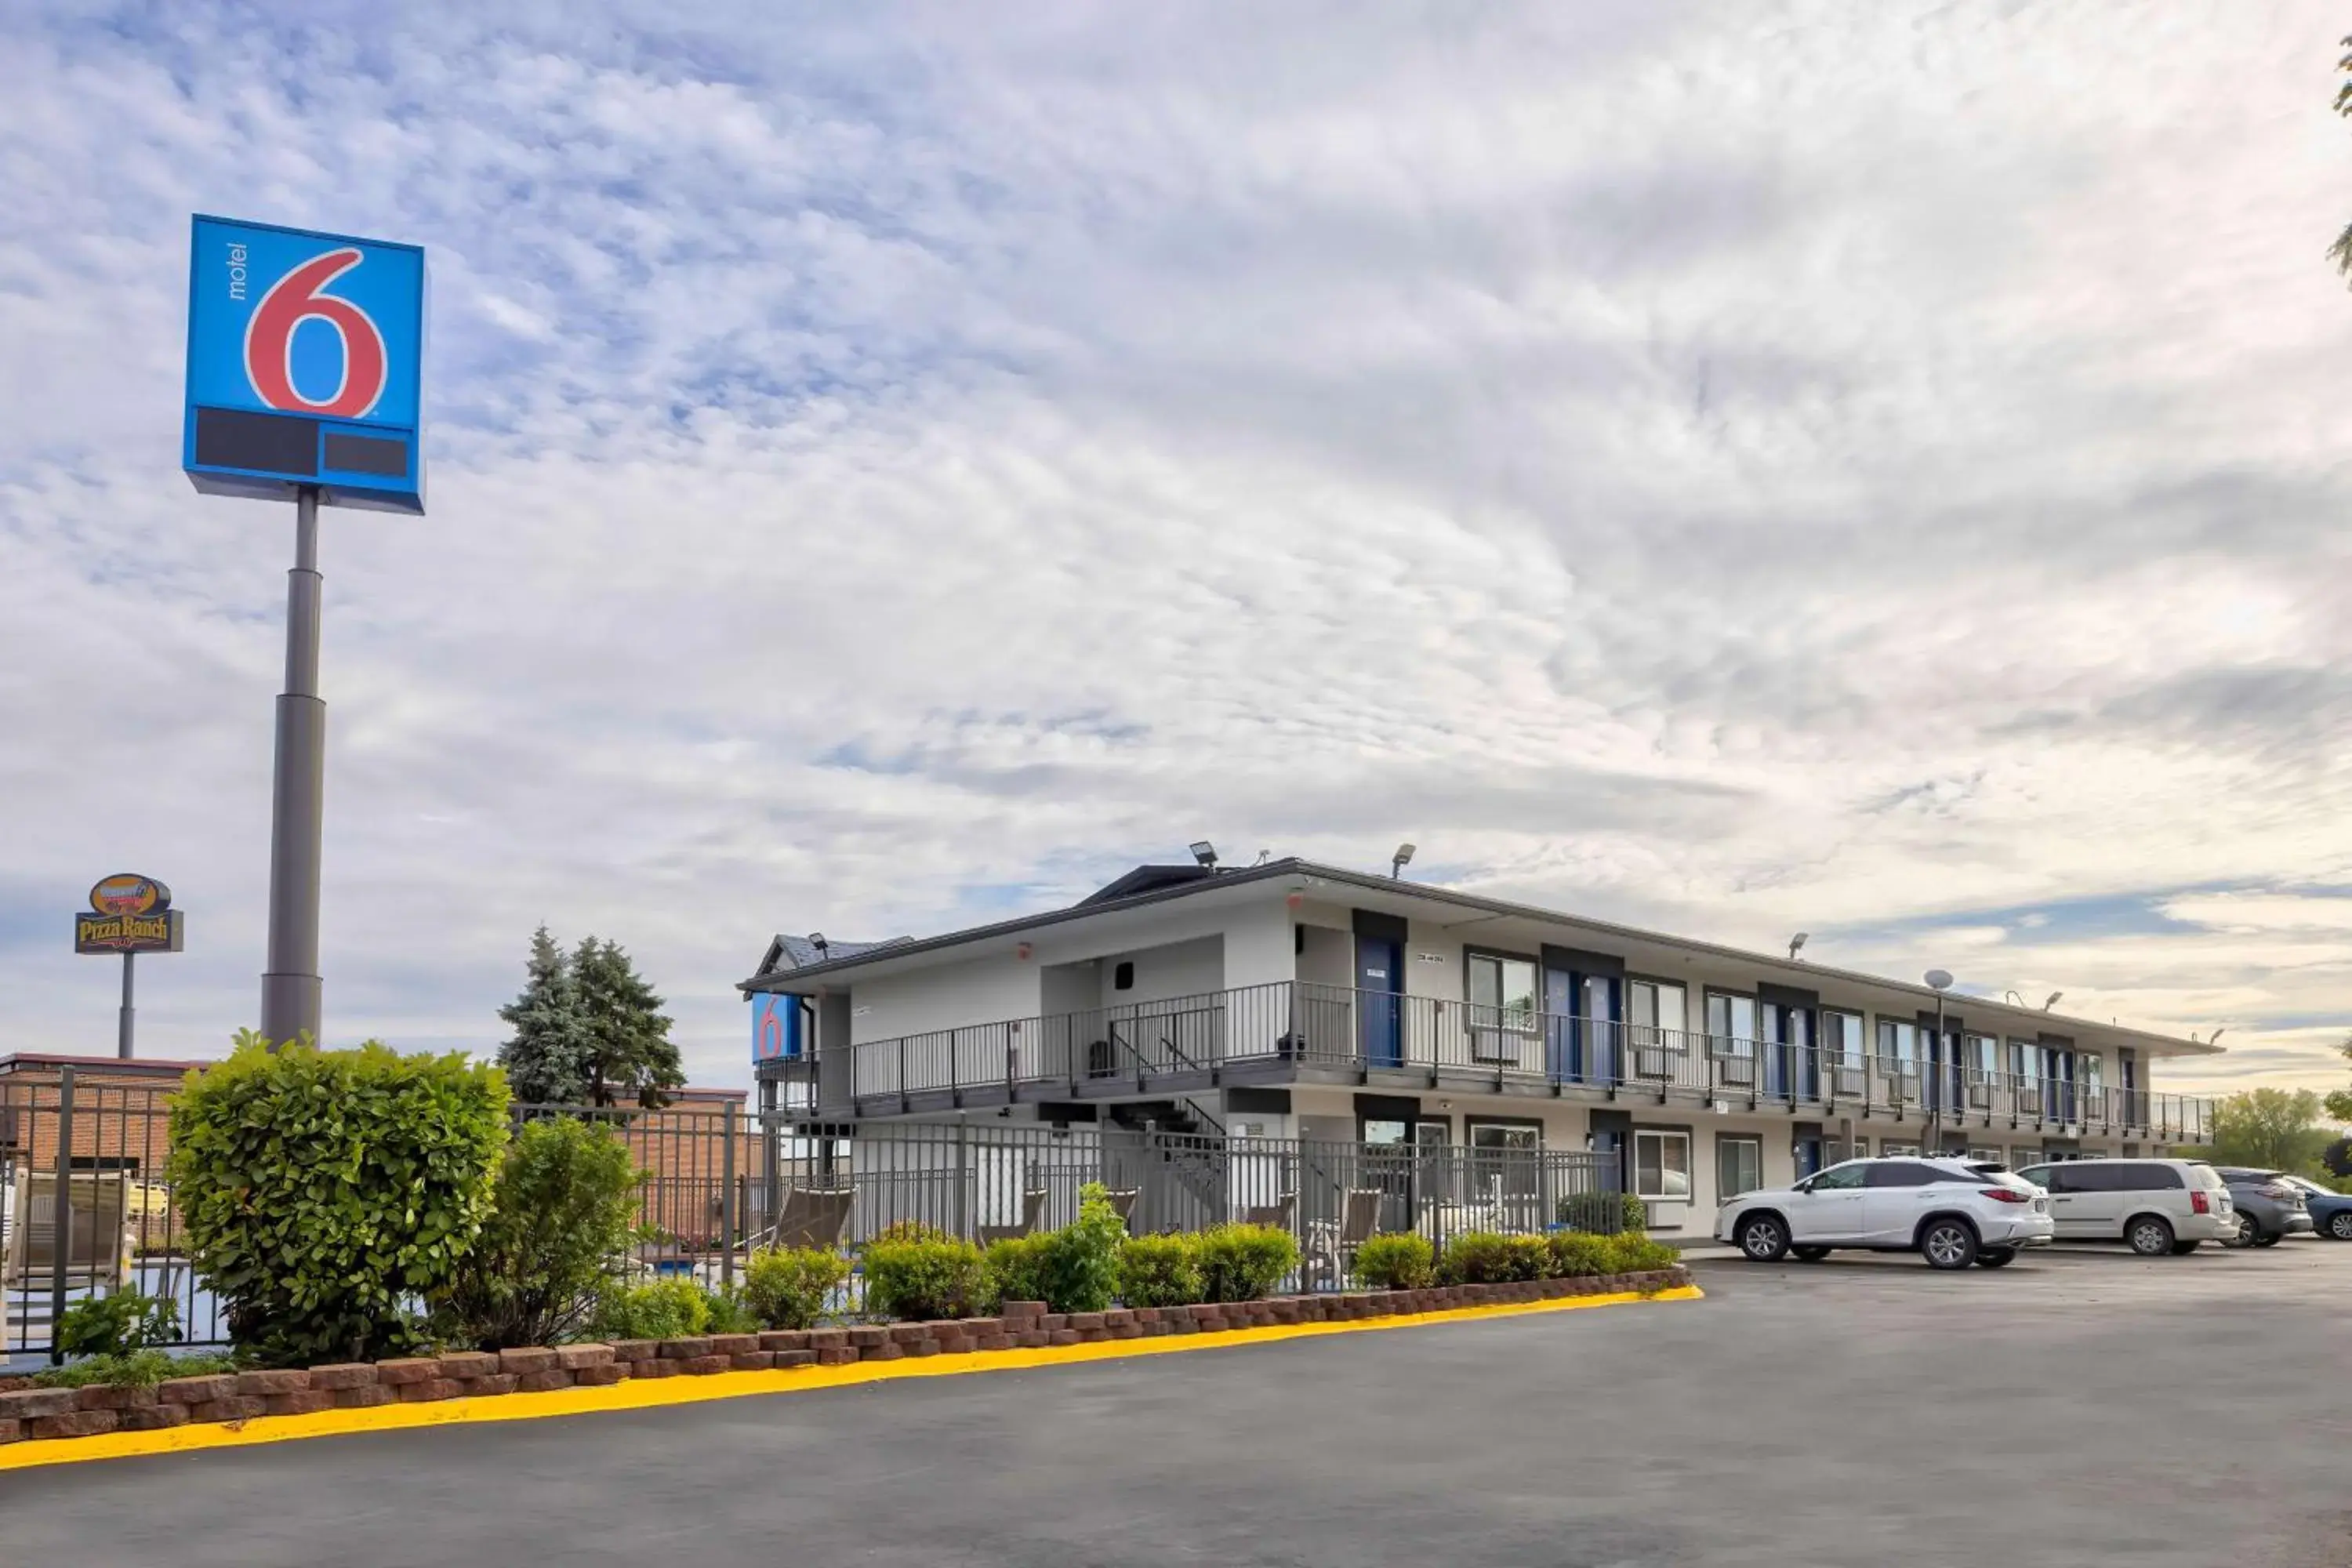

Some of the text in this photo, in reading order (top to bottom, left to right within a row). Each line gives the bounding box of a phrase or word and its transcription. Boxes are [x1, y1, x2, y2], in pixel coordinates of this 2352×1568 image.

[225, 242, 248, 299] motel
[243, 246, 389, 419] 6
[79, 916, 167, 941] Pizza Ranch
[758, 993, 782, 1060] 6
